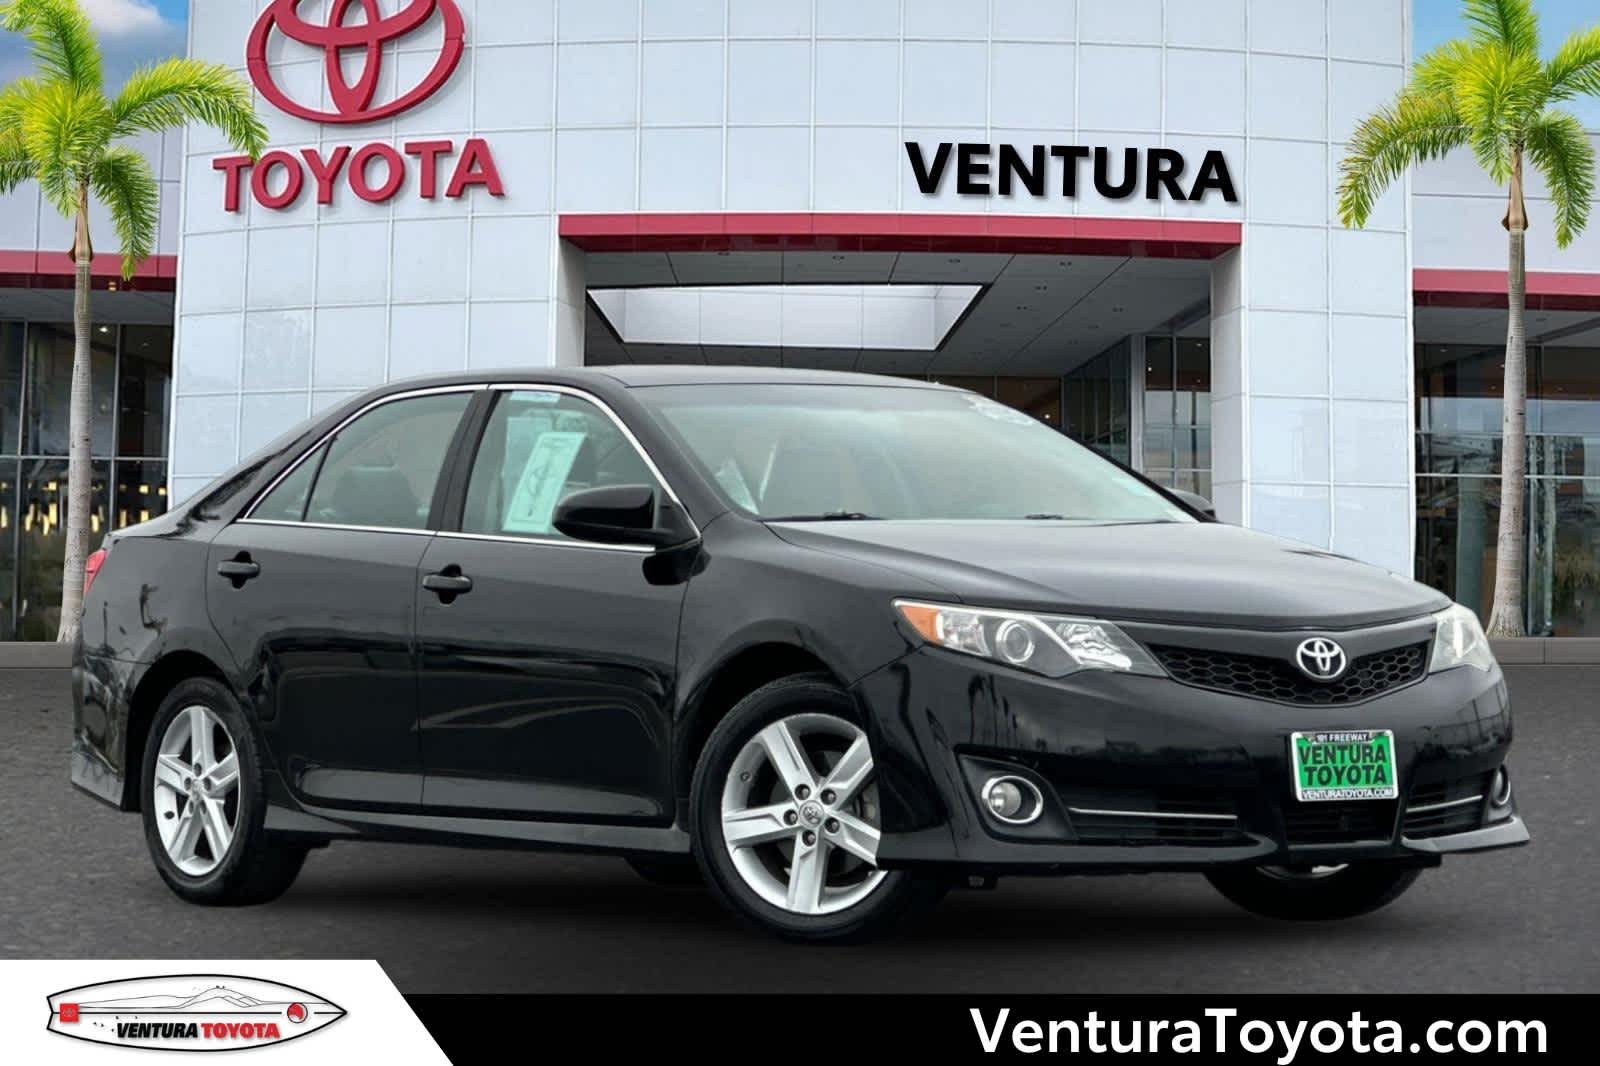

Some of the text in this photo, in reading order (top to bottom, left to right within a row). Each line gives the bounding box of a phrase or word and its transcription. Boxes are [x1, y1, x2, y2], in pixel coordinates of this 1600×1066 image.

[212, 138, 505, 213] TOYOTA
[904, 141, 1237, 203] VENTURA
[1329, 733, 1367, 742] FREEWAY
[1298, 743, 1386, 765] VENTURA
[1304, 764, 1388, 786] TOYOTA
[1302, 788, 1393, 799] VENTURATOYOTA.COM
